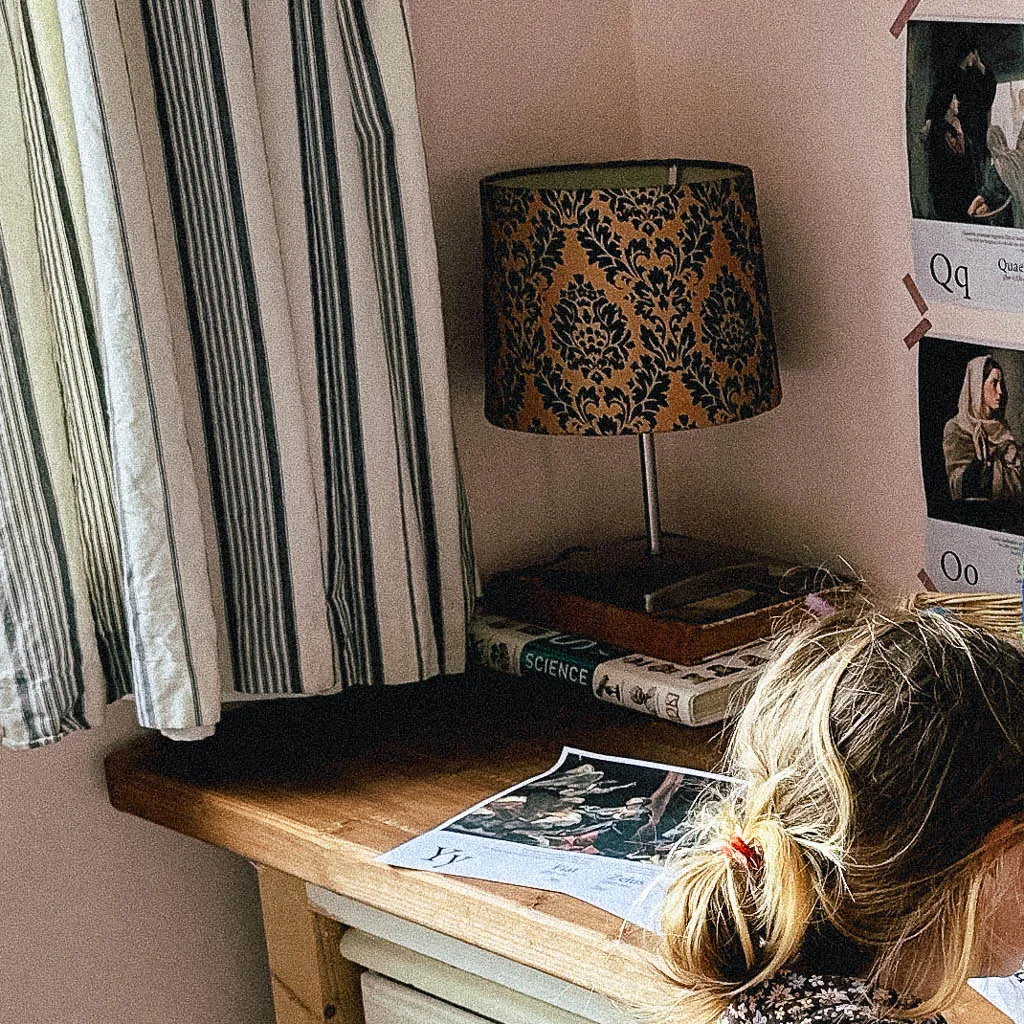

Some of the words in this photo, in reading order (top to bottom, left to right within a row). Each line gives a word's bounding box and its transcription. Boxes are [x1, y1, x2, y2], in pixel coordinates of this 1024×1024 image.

[929, 252, 971, 300] Qq
[940, 550, 979, 586] Oo
[525, 652, 589, 686] SCIENCE
[421, 846, 473, 868] Yy
